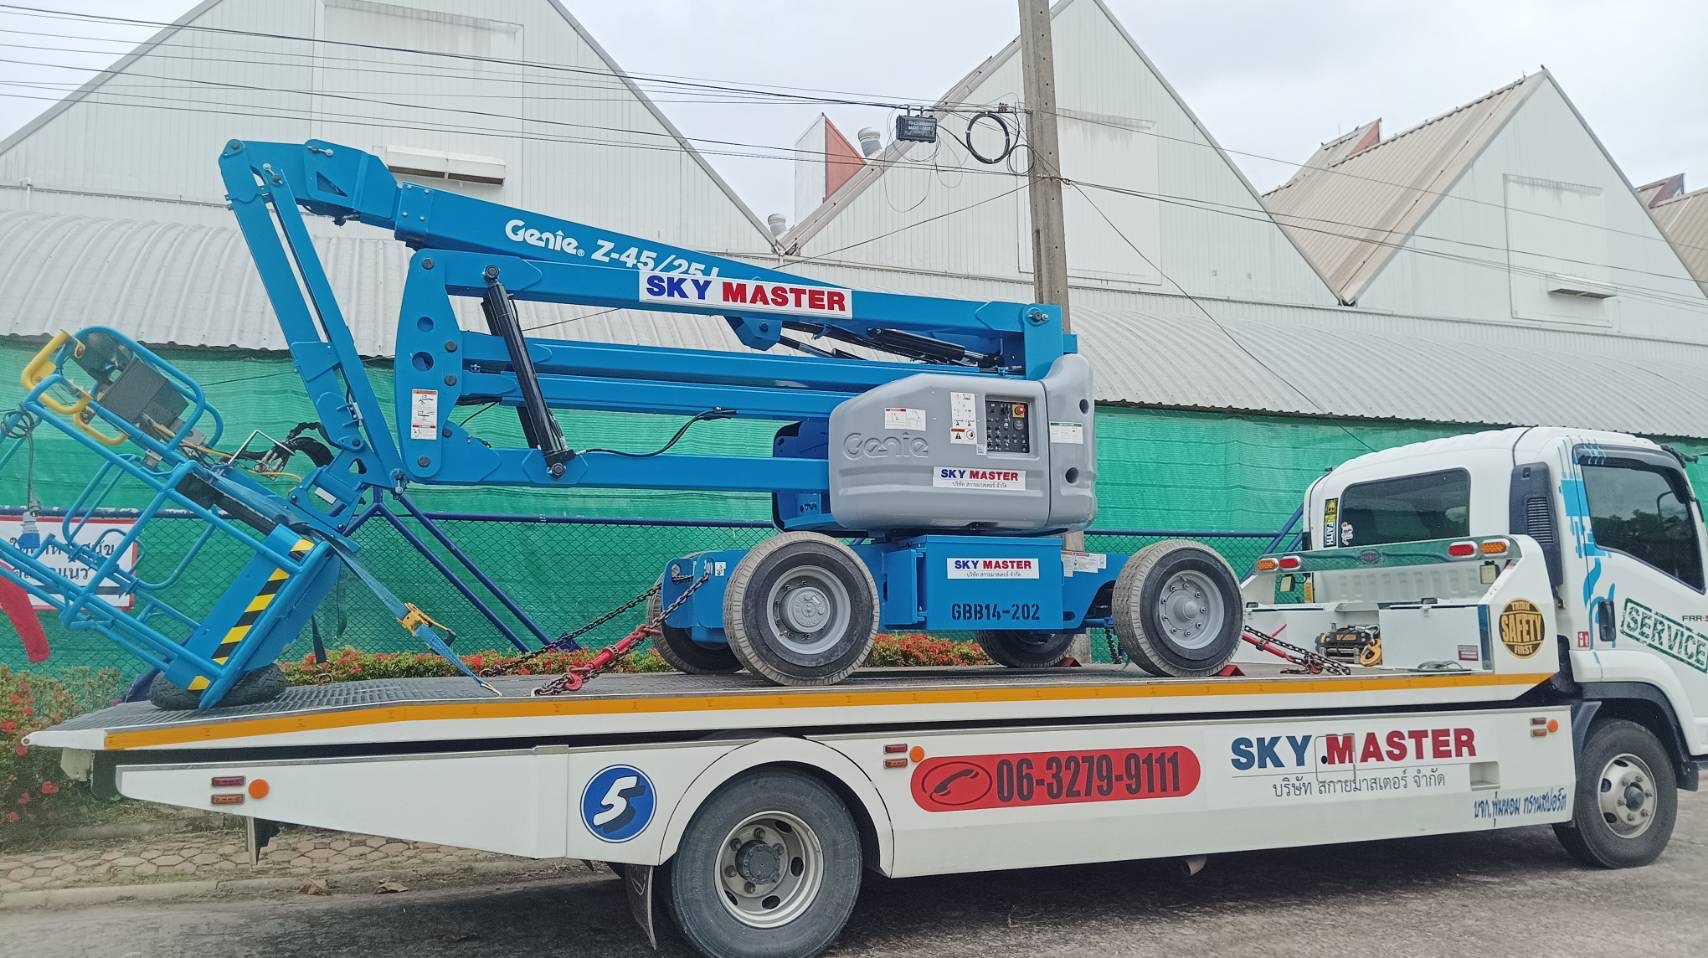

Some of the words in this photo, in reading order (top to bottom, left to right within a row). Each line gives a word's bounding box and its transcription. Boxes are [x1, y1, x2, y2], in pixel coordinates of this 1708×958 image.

[646, 275, 713, 300] SKY
[722, 282, 847, 312] MASTER
[843, 431, 929, 461] Genie
[940, 468, 966, 479] SKY
[969, 470, 1019, 482] MASTER
[954, 559, 979, 570] SKY
[982, 560, 1032, 570] MASTER
[951, 602, 1040, 621] GBB14-202
[1501, 613, 1542, 643] SAFETY
[1626, 606, 1706, 666] SERVICE
[1513, 644, 1533, 655] FIRST
[1230, 735, 1313, 771] SKY
[1325, 727, 1478, 766] MASTER
[996, 751, 1181, 803] 06-3279-9111
[1272, 775, 1312, 798] บริษัท
[1317, 769, 1409, 795] สกายมาสเตอร์
[1413, 767, 1446, 788] จำกัด
